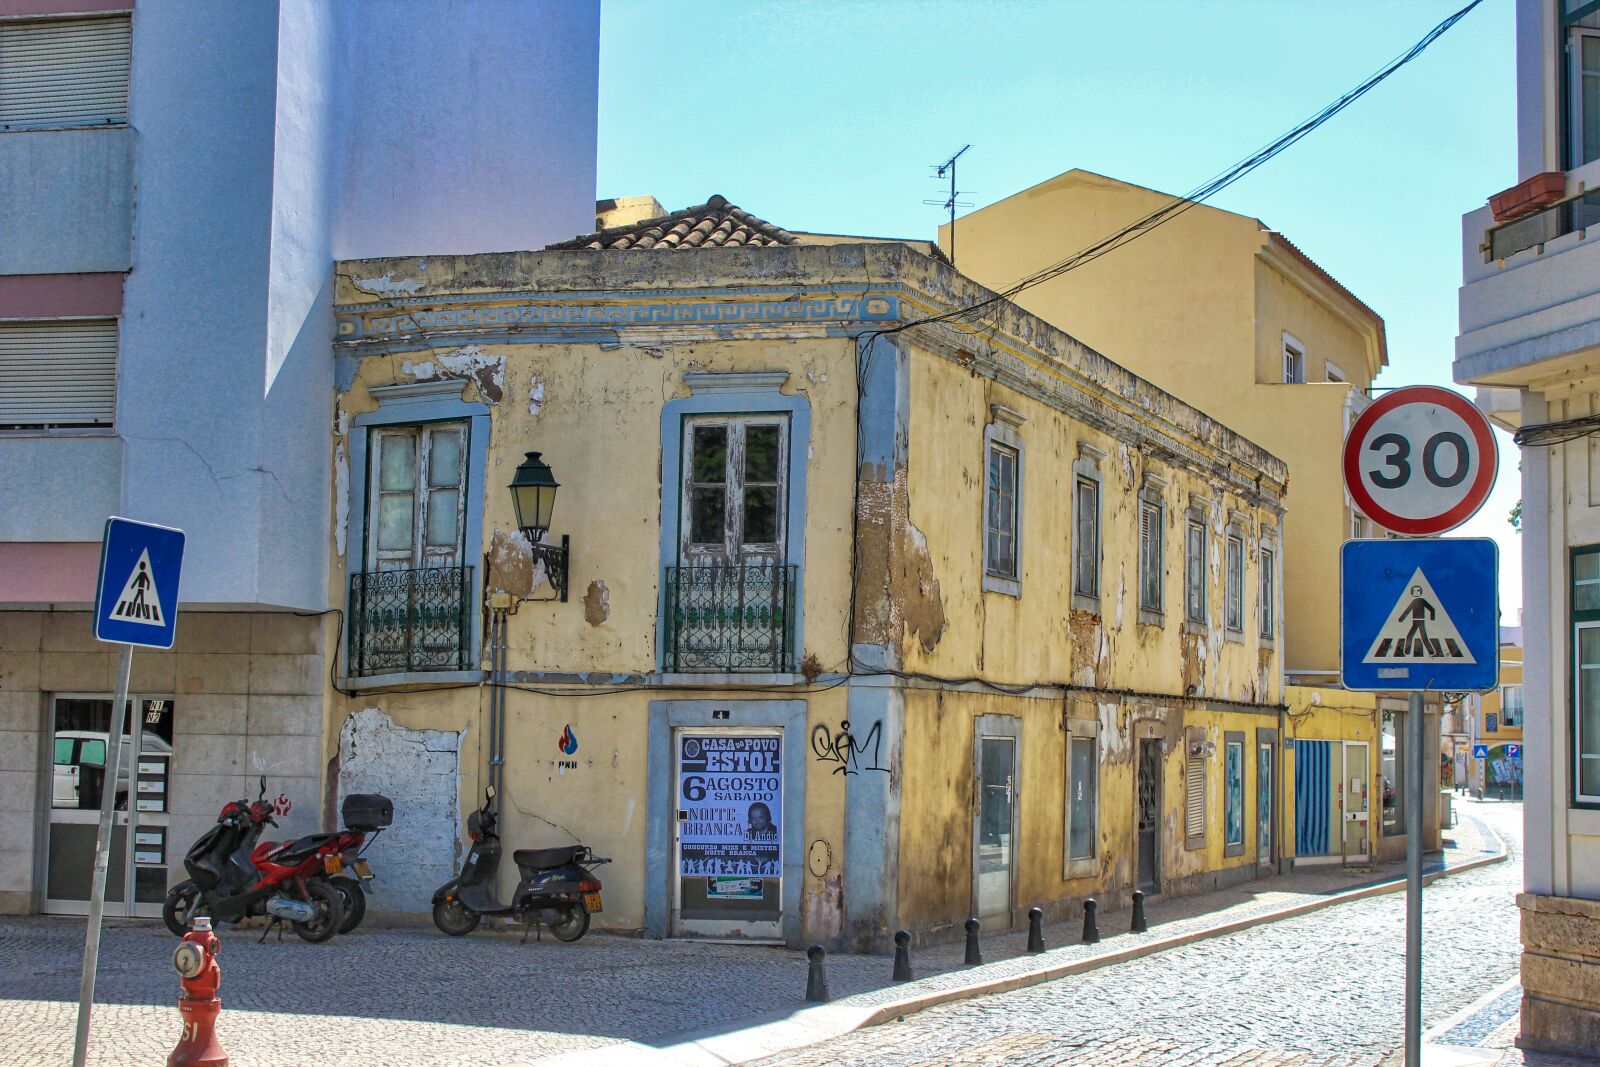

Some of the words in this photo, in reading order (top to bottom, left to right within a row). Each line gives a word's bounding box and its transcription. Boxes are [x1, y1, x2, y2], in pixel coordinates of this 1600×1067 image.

[1368, 431, 1470, 489] 30
[146, 712, 161, 723] N2
[702, 739, 735, 751] CASA
[735, 740, 745, 749] DO
[744, 739, 778, 751] POVO
[706, 752, 774, 772] ESTOI
[682, 775, 707, 801] 6
[706, 777, 779, 791] AGOSTO
[683, 822, 743, 836] BRANCA
